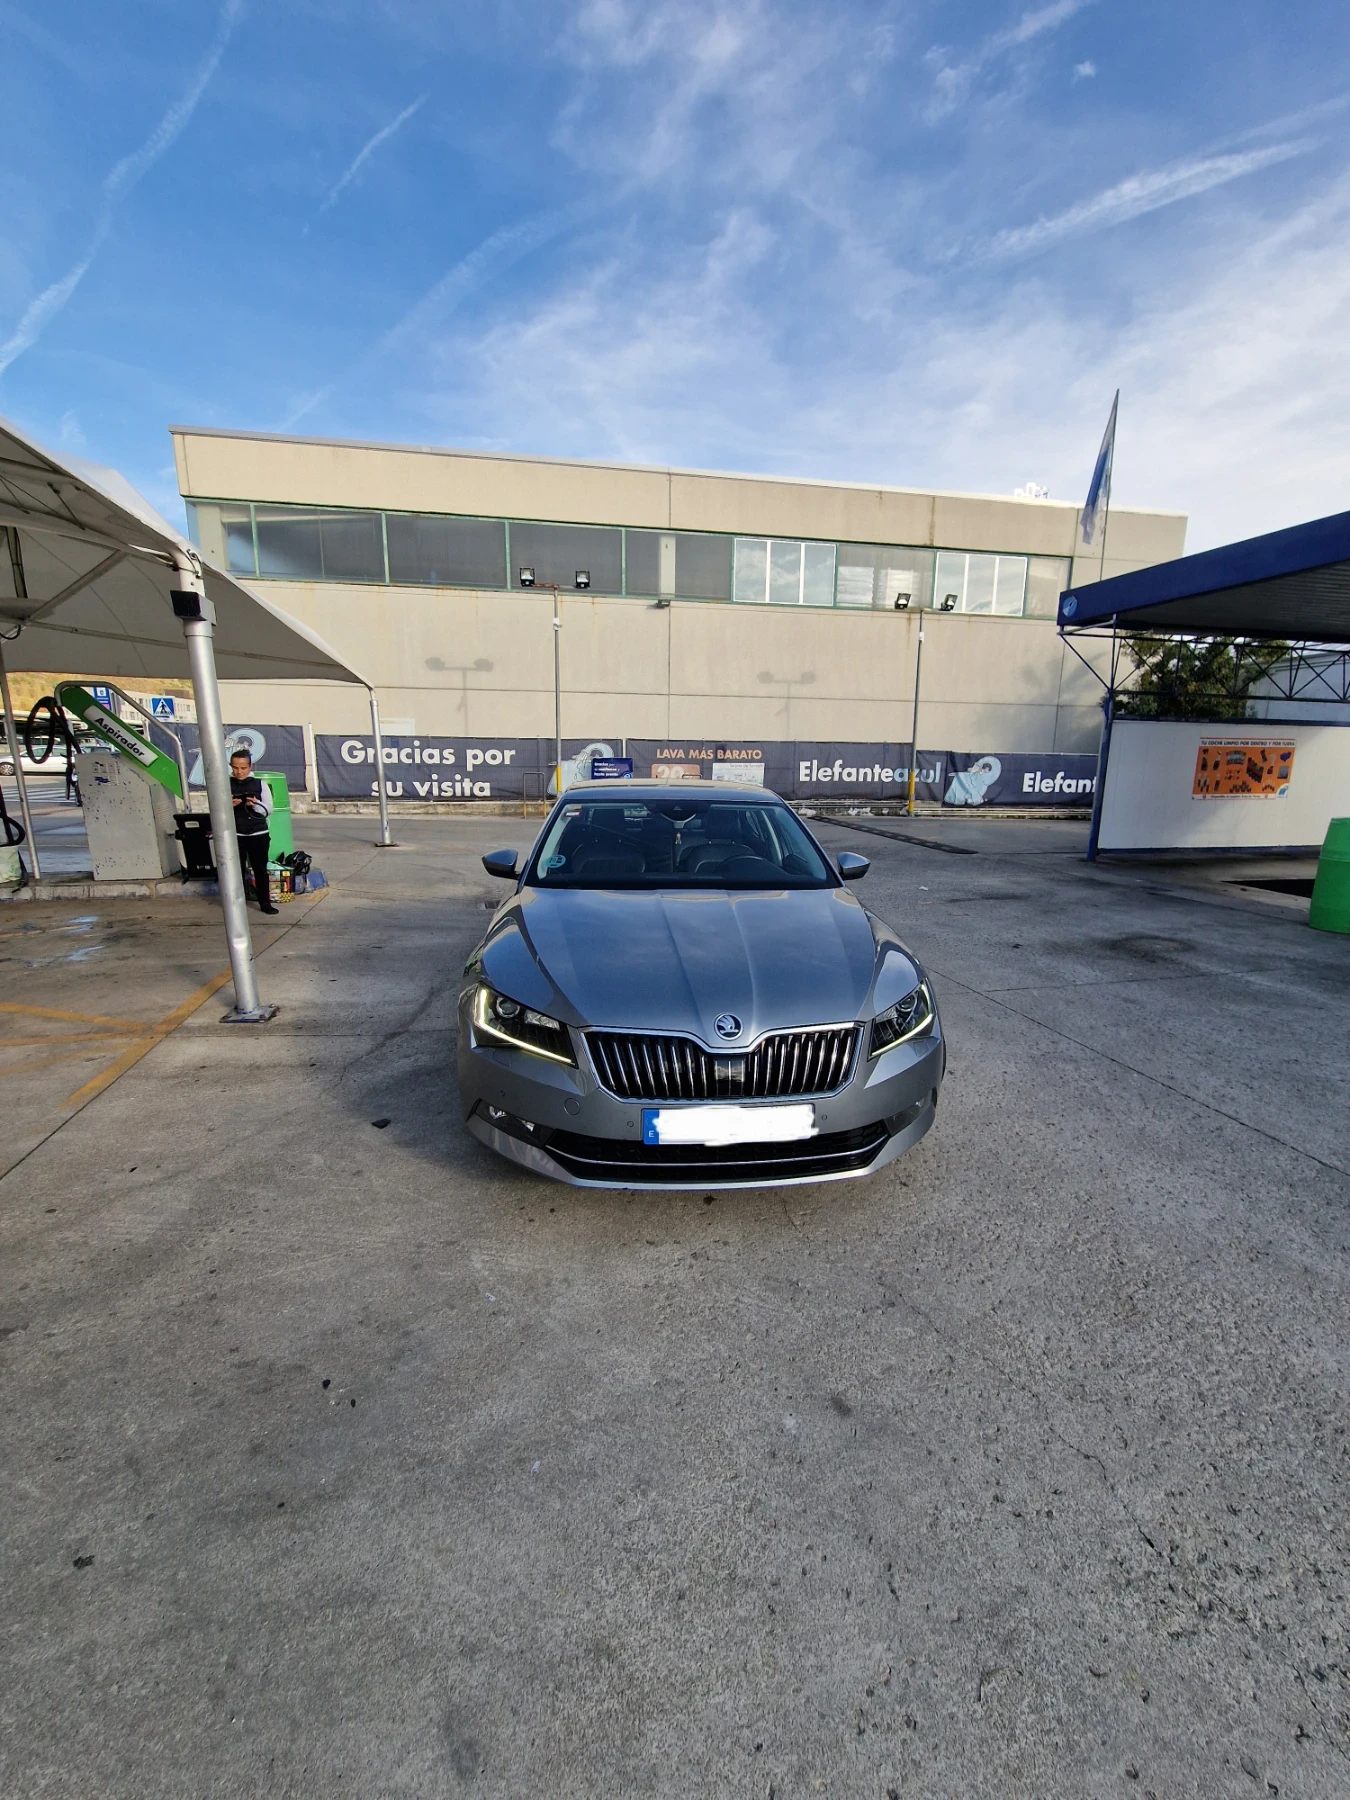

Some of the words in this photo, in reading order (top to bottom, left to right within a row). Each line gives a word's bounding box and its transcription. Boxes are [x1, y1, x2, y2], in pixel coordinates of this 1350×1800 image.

[94, 717, 145, 757] Aspirador
[340, 739, 456, 764] Gracias
[466, 748, 516, 772] por
[656, 748, 685, 759] LAVA
[688, 746, 714, 760] MÁS
[717, 749, 762, 760] BARATO
[412, 773, 492, 797] visita
[648, 1130, 655, 1138] E
